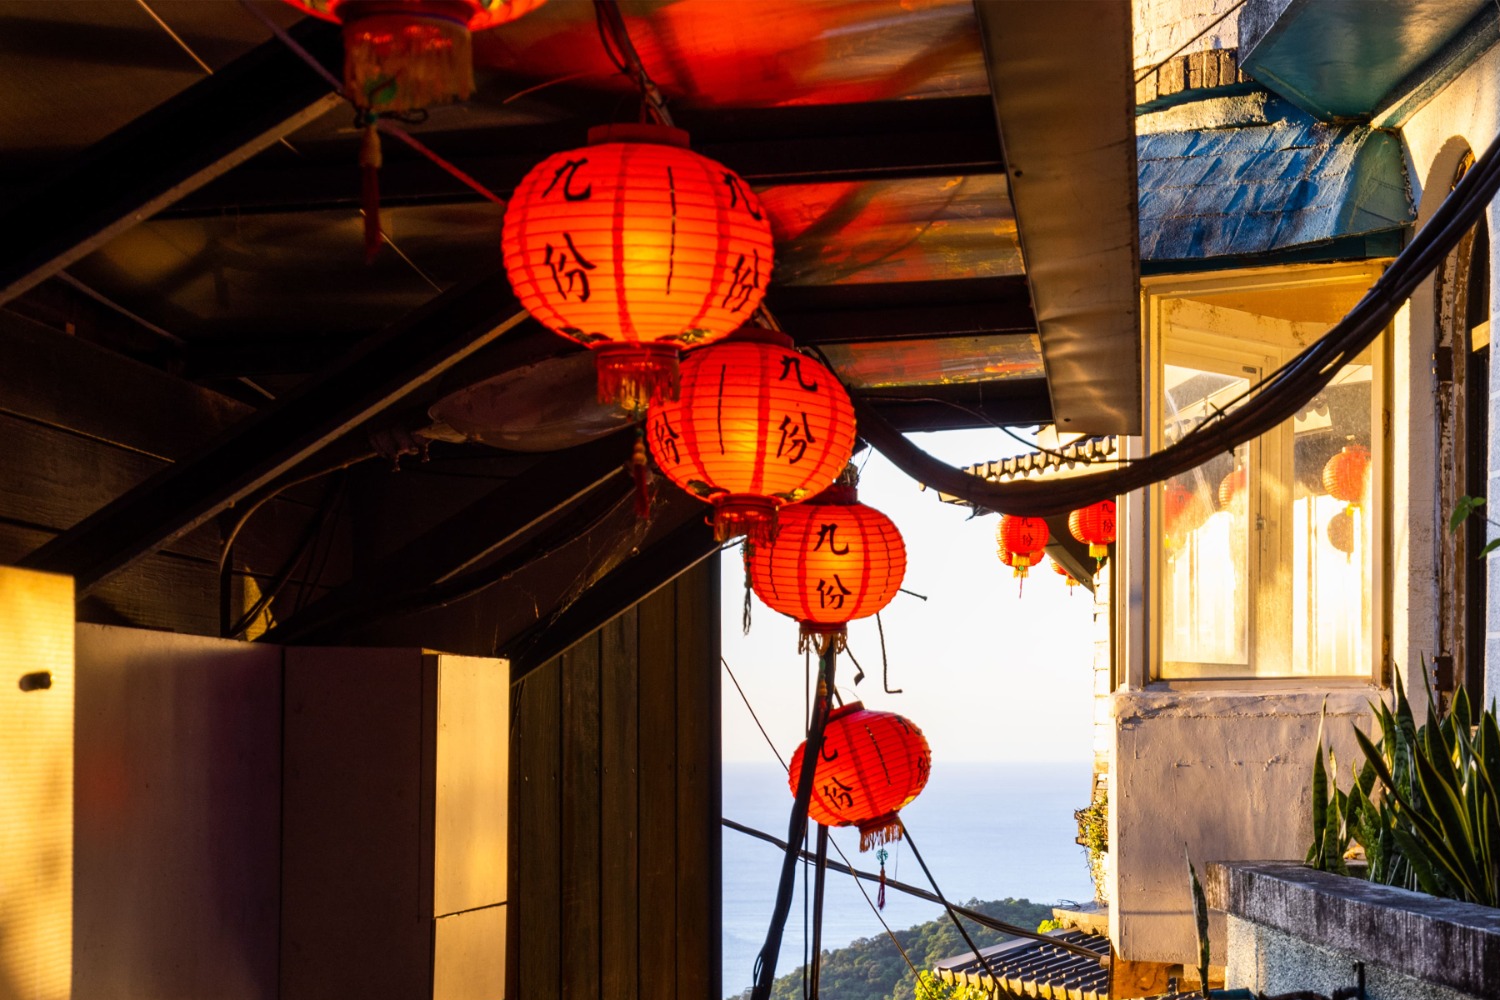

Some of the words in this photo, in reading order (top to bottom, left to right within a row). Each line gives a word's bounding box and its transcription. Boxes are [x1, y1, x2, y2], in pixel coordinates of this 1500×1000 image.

[541, 157, 597, 302] 九份
[720, 170, 763, 313] 九份
[777, 354, 818, 465] 九份
[813, 513, 852, 610] 九份
